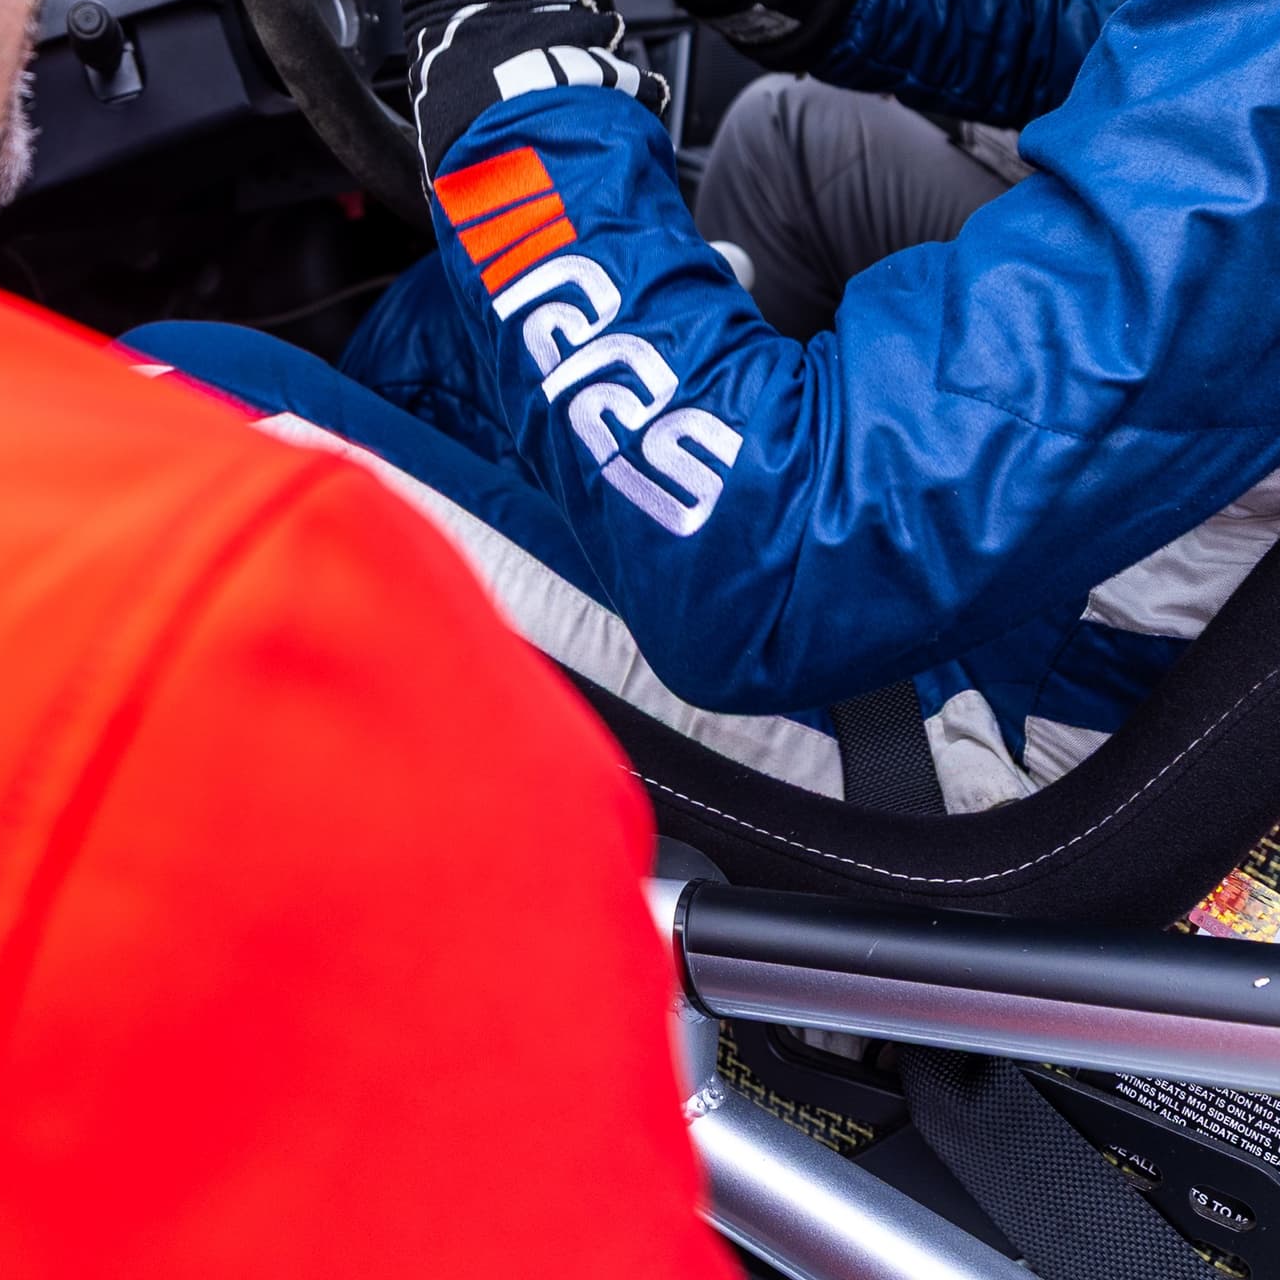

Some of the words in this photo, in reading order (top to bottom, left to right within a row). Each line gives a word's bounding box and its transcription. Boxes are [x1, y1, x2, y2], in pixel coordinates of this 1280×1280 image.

[1116, 1082, 1138, 1099] AND
[1137, 1095, 1160, 1112] MAY
[1160, 1108, 1187, 1128] ALSO
[1154, 1078, 1186, 1100] SEATS
[1187, 1096, 1206, 1112] M10
[1207, 1107, 1273, 1149] SIDEMOUNTS.
[1157, 1093, 1180, 1111] WILL
[1181, 1107, 1239, 1144] INVALIDATE
[1240, 1138, 1263, 1156] THIS
[1188, 1083, 1215, 1102] SEAT
[1215, 1097, 1226, 1108] IS
[1226, 1104, 1255, 1123] ONLY
[1212, 1085, 1253, 1108] ATION
[1253, 1104, 1274, 1120] M10
